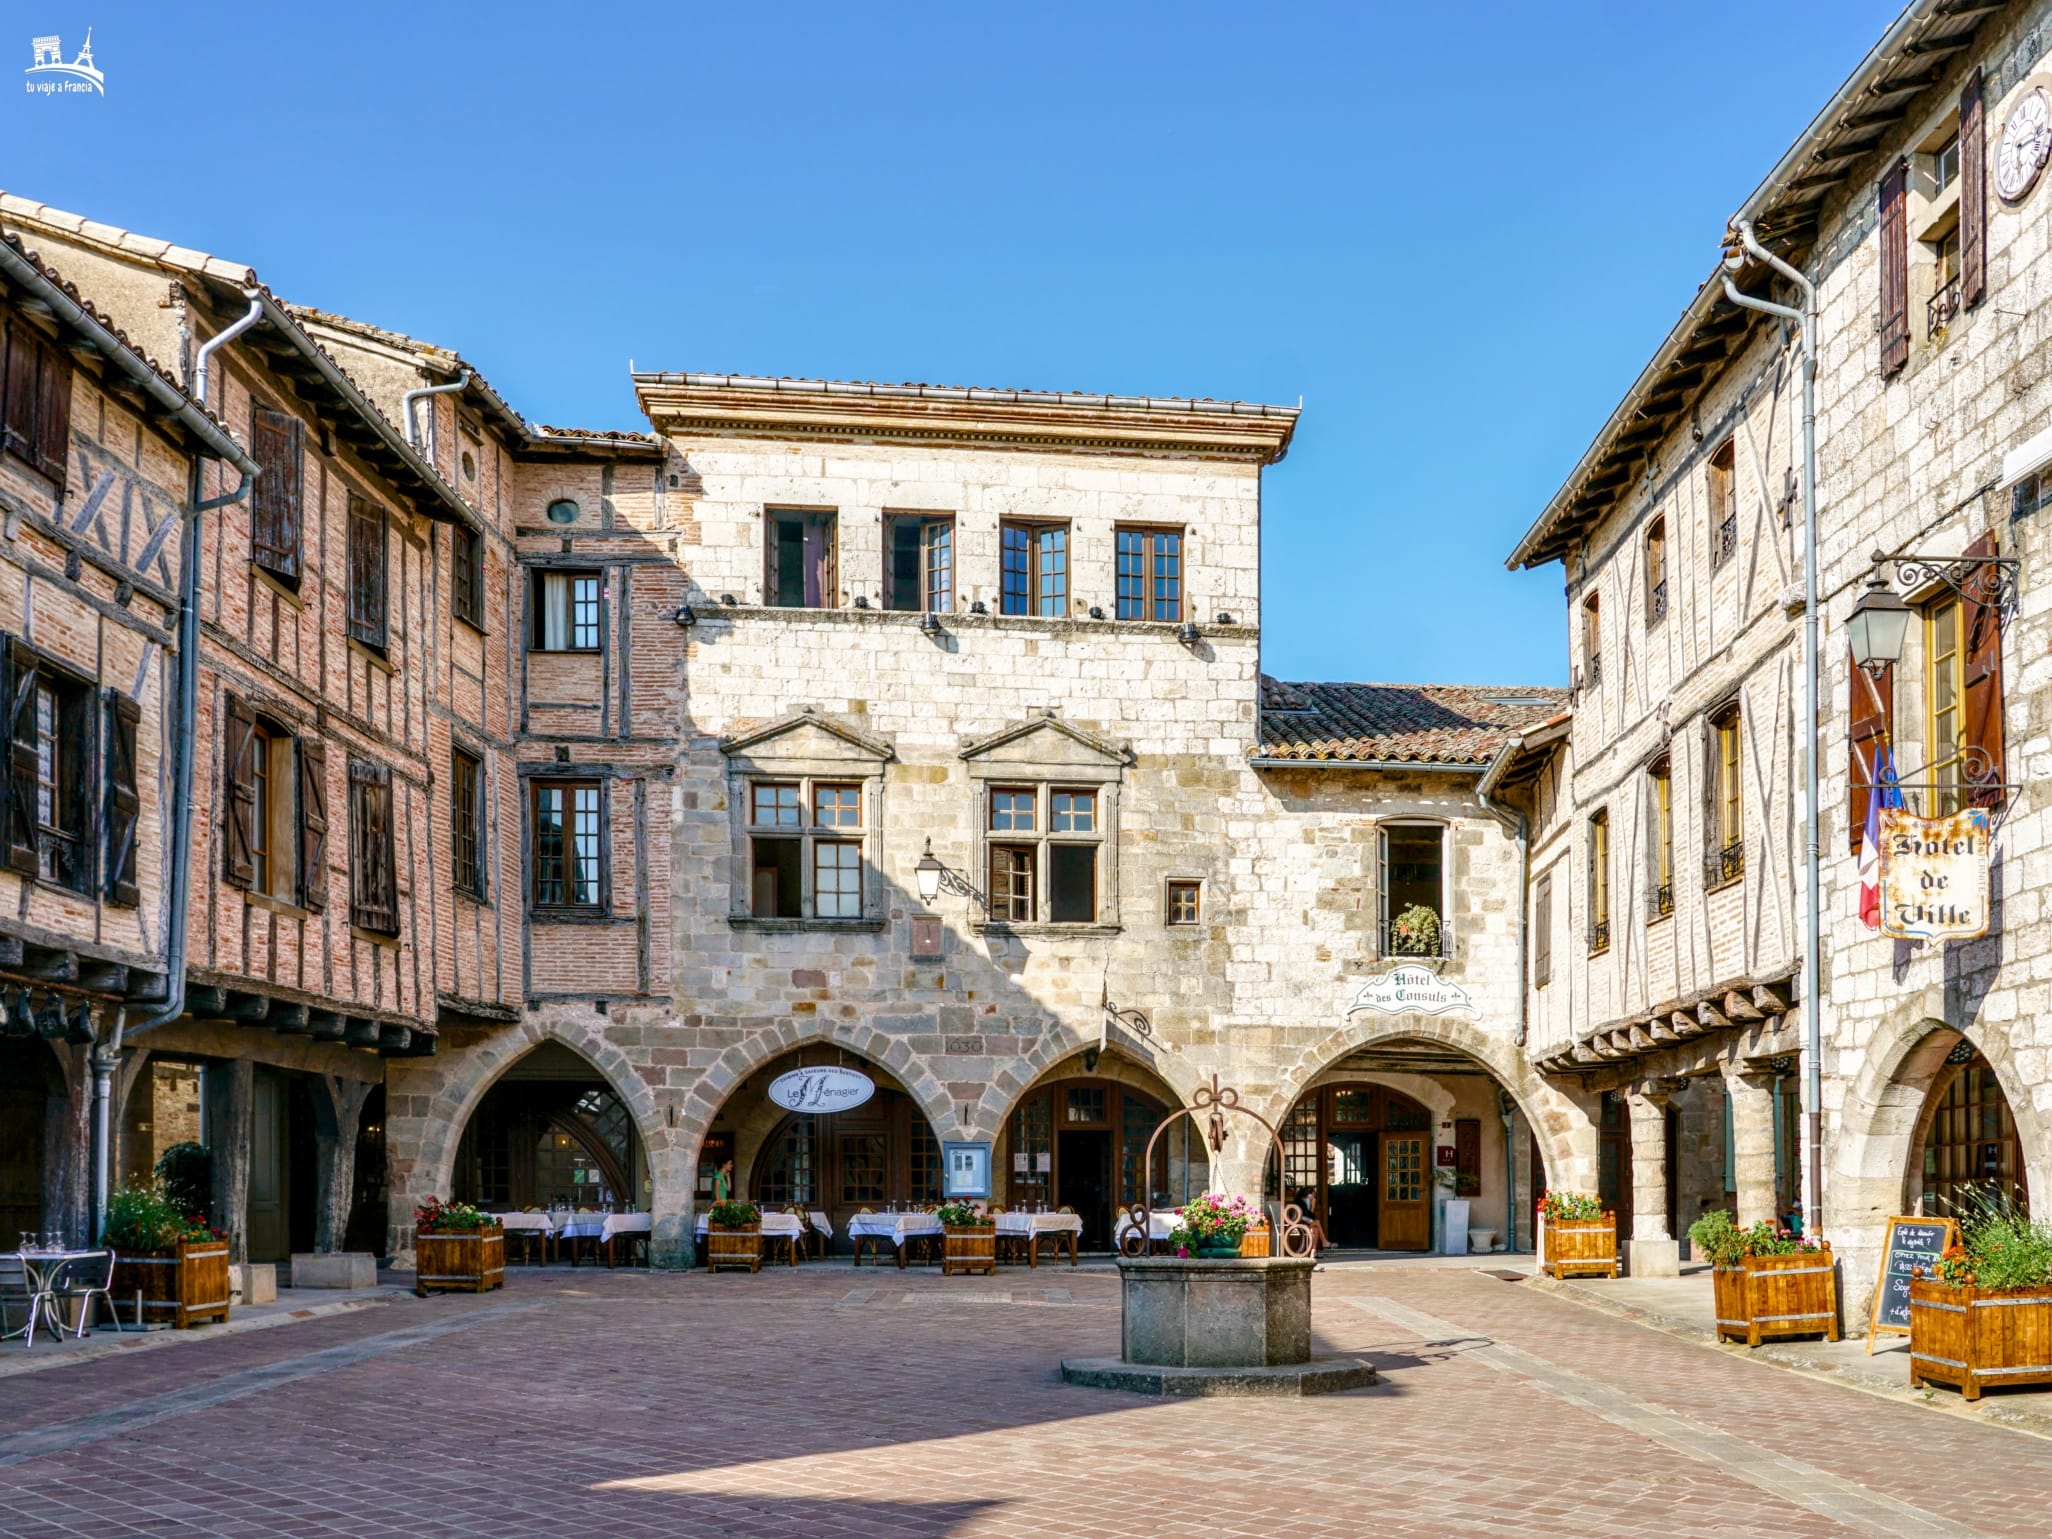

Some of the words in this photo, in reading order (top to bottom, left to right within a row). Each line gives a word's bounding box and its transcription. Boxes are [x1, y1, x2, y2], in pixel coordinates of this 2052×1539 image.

[1892, 833, 1974, 857] Hotel
[1920, 869, 1948, 889] de
[1894, 903, 1970, 925] Ville
[1393, 972, 1430, 986] Hôtel
[1376, 993, 1391, 1003] des
[1395, 989, 1447, 1003] Consuls
[946, 1037, 983, 1054] 1630
[787, 1088, 799, 1099] Le
[788, 1075, 859, 1107] Ménagier
[1445, 1150, 1454, 1158] H
